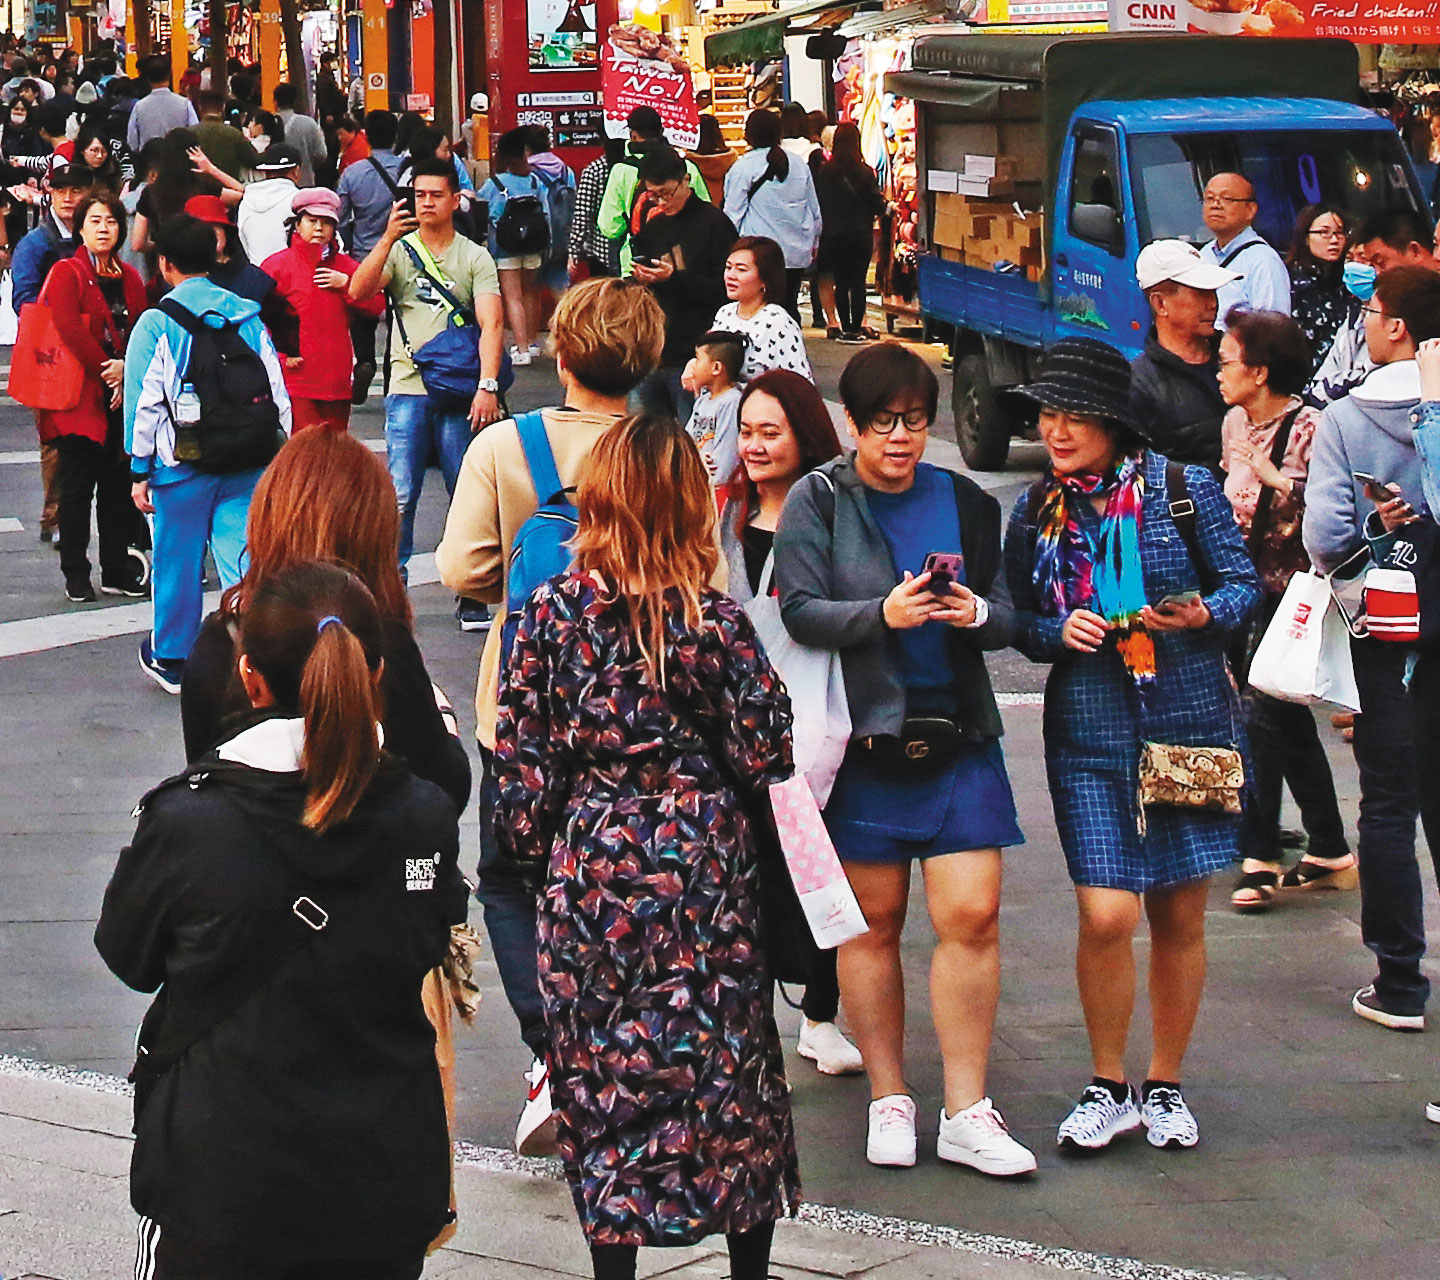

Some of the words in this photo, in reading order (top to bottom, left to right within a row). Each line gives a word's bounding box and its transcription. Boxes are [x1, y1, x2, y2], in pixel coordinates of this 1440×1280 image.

[1127, 3, 1176, 20] CNN
[1311, 2, 1359, 18] Fried
[1364, 2, 1438, 19] chicken!!
[367, 17, 385, 29] 41
[606, 57, 684, 83] Taiwan
[672, 133, 697, 144] CNN
[406, 859, 433, 870] SUPER
